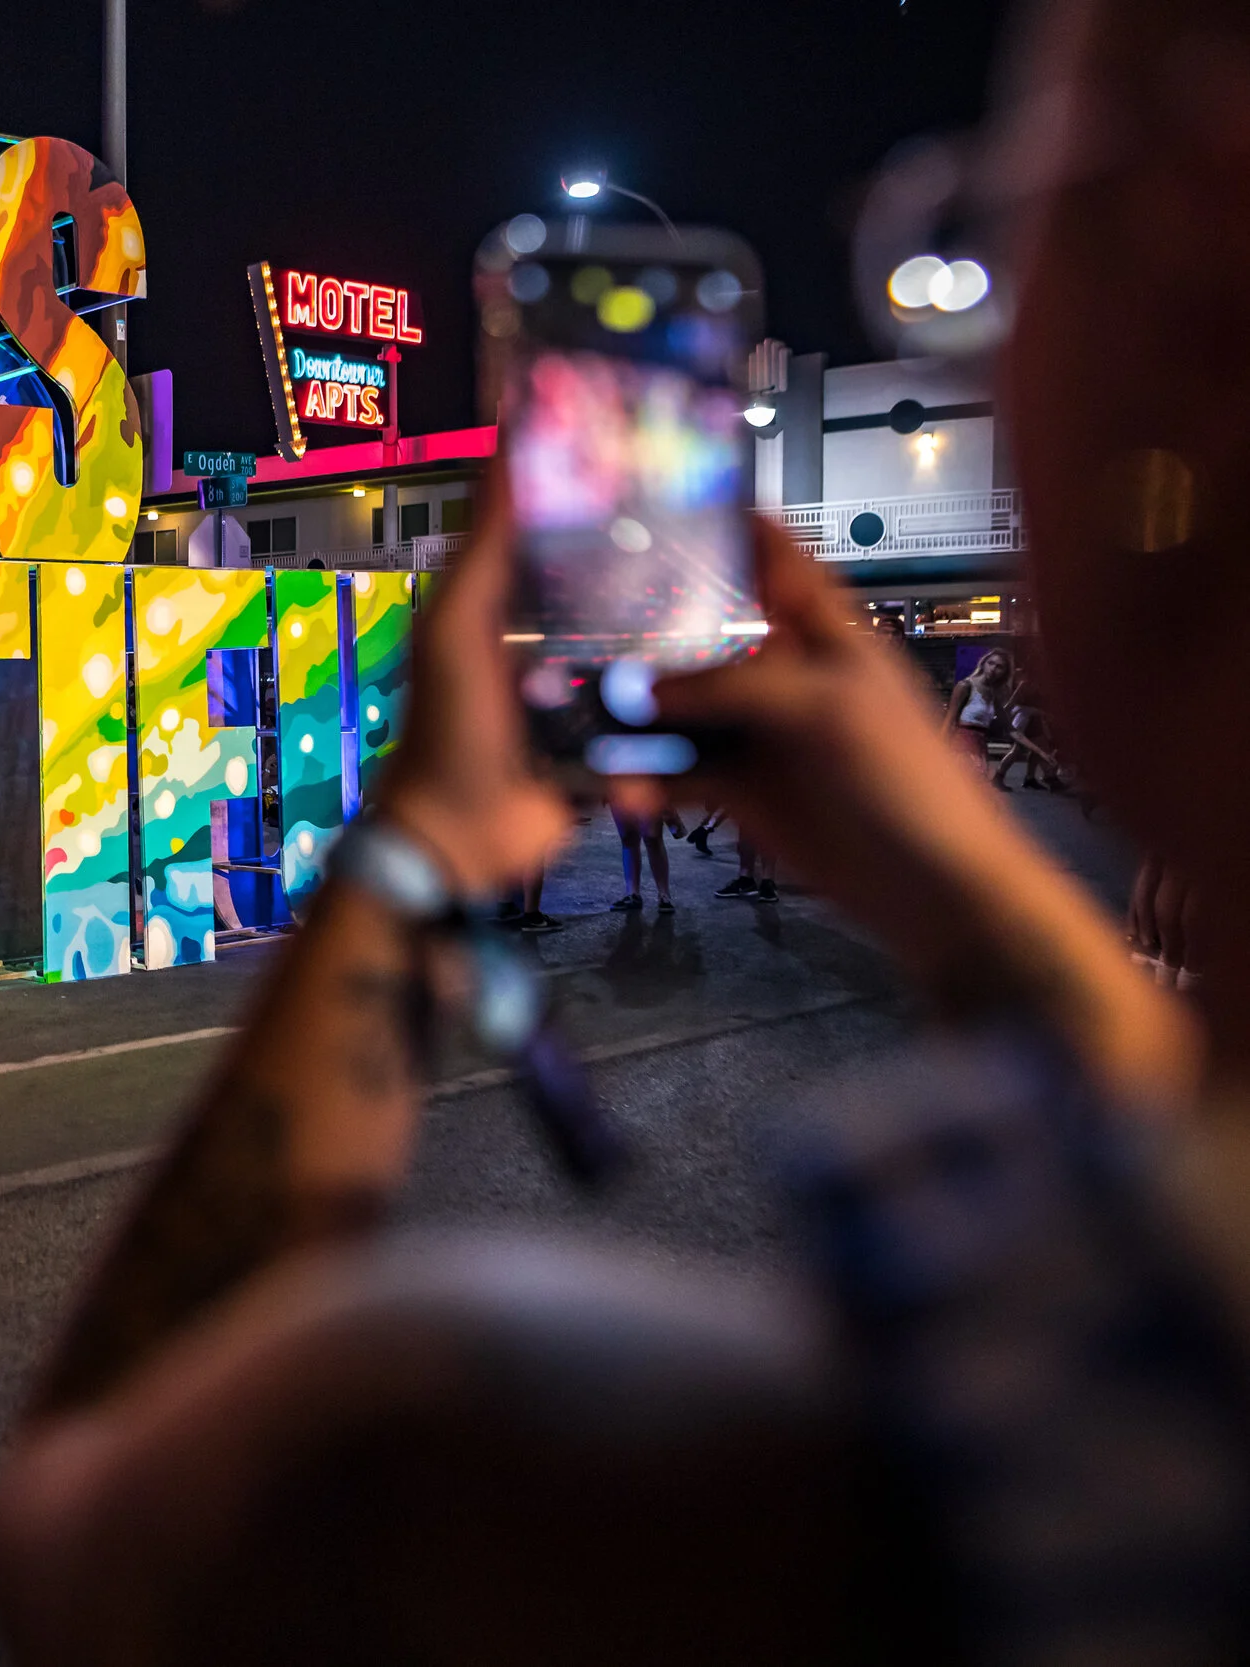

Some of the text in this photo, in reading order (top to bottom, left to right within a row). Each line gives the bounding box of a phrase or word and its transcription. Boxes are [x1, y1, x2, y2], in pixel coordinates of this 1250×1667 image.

[288, 271, 422, 344] MOTEL
[293, 347, 386, 388] Downtowner
[304, 379, 384, 425] APTS.
[187, 453, 252, 476] E Ogden AVE
[208, 484, 224, 502] 8th
